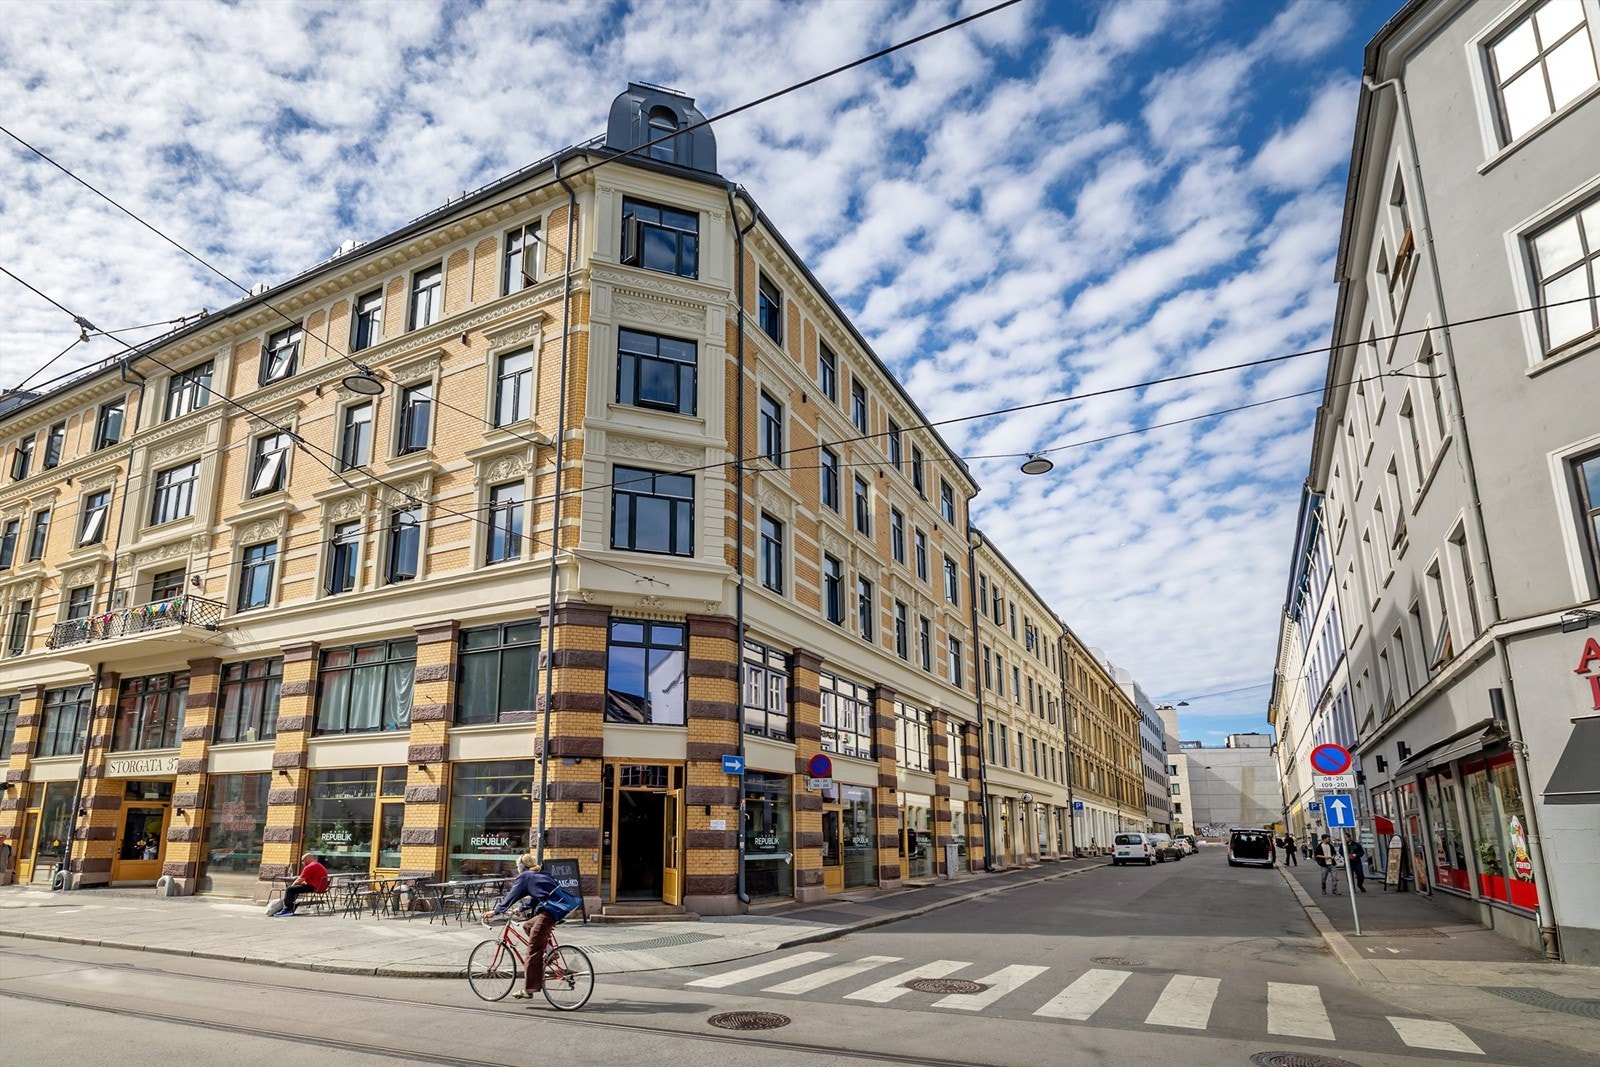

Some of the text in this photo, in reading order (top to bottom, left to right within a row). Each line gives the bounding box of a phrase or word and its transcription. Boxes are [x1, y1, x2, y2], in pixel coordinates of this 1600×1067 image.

[109, 758, 163, 774] STORGATA
[321, 833, 352, 841] REPUBLIK
[470, 837, 509, 846] REPUBLIK
[754, 837, 780, 845] REPUBLIK
[551, 864, 572, 876] ÅPEN
